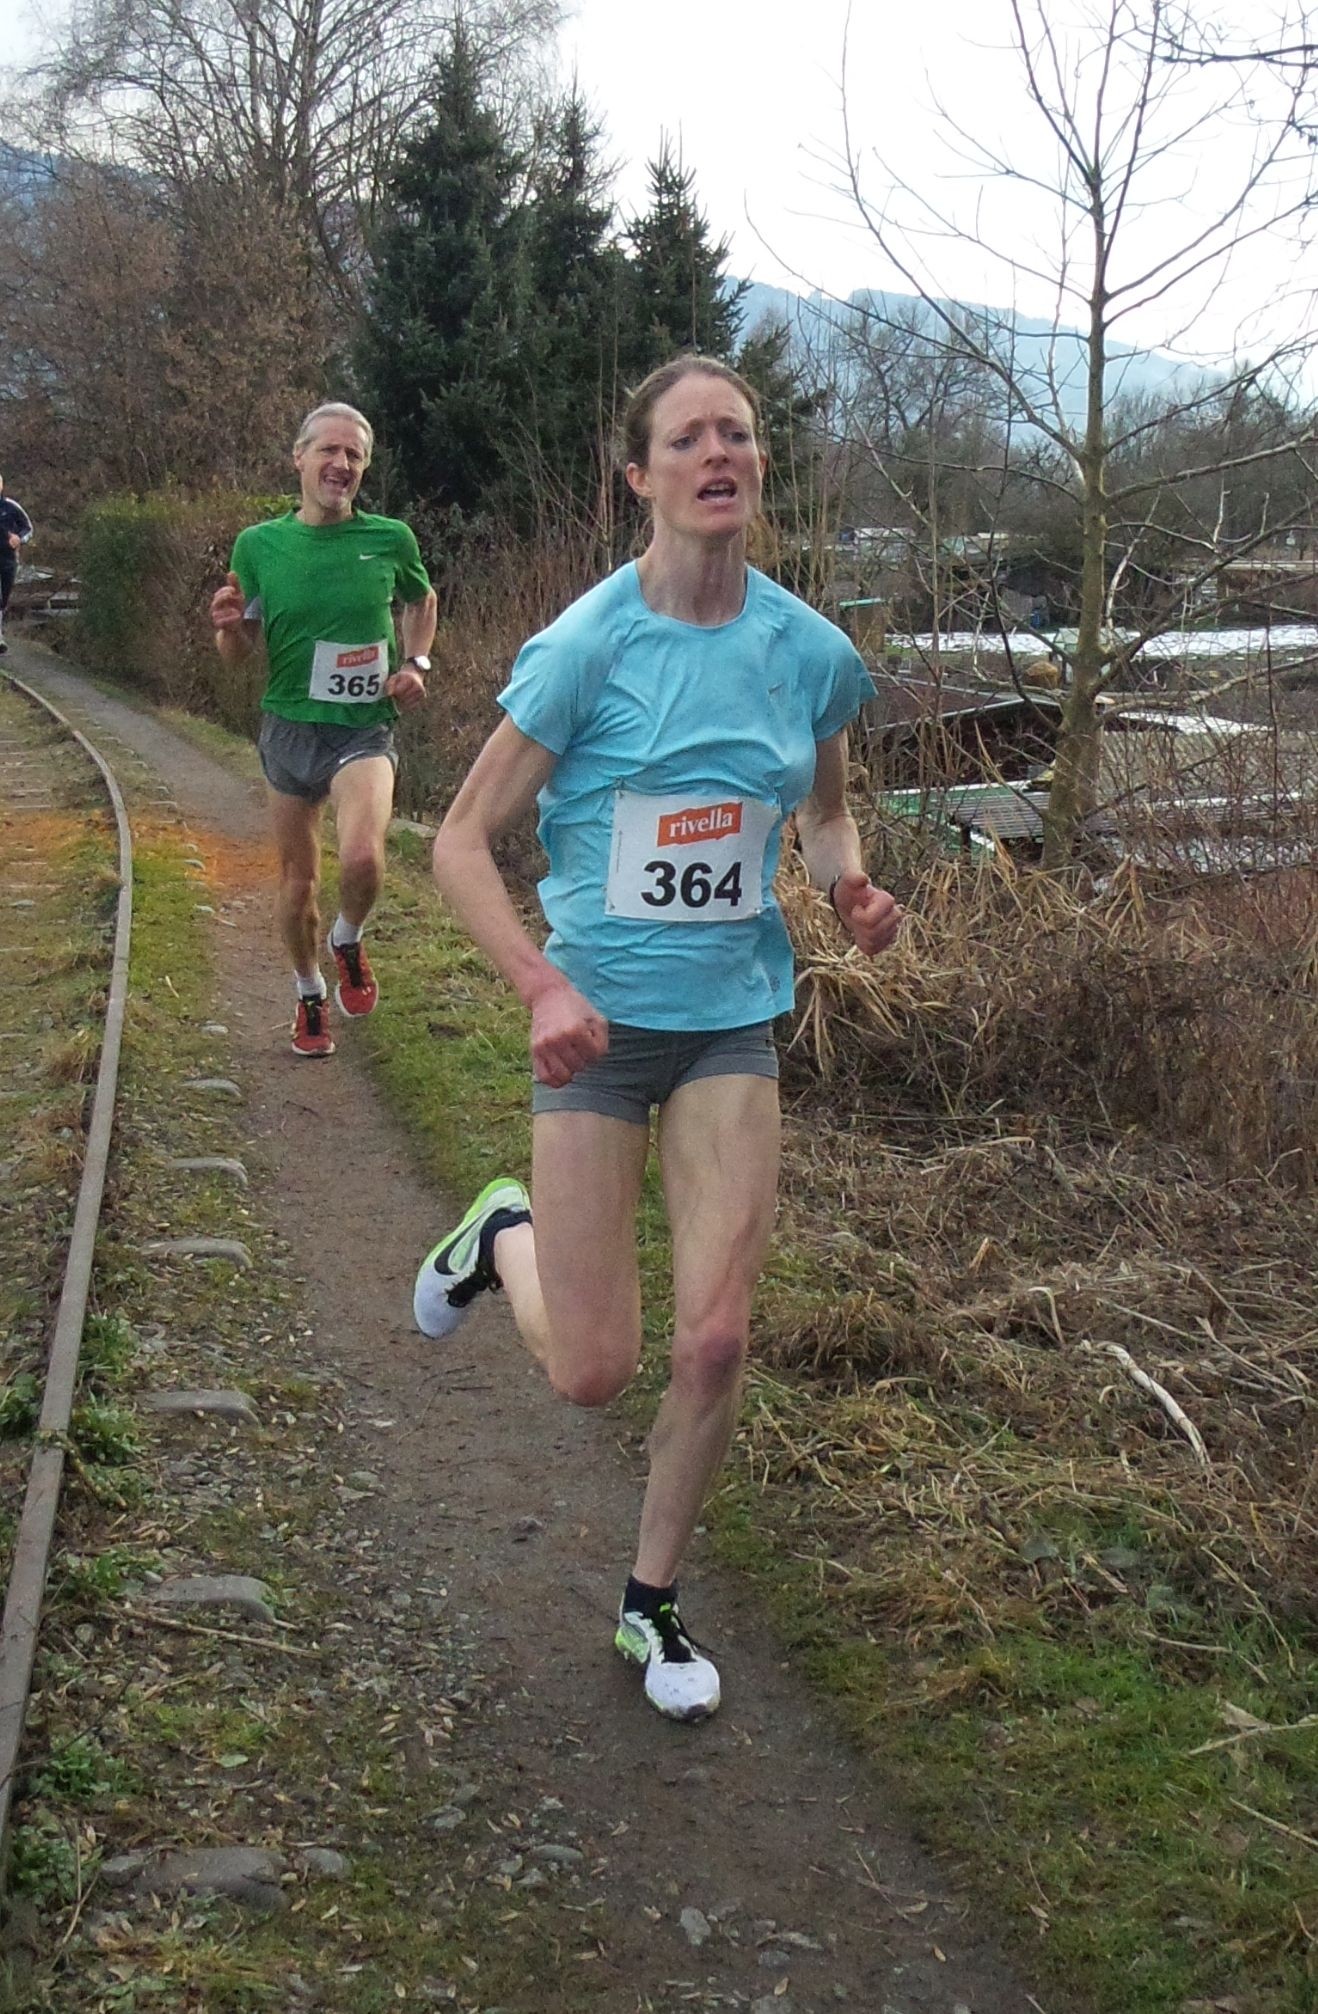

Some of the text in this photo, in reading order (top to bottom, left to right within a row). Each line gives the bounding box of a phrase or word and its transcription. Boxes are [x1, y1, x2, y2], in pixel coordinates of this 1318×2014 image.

[328, 673, 380, 697] 365
[669, 807, 733, 838] rivella
[641, 860, 742, 908] 364
